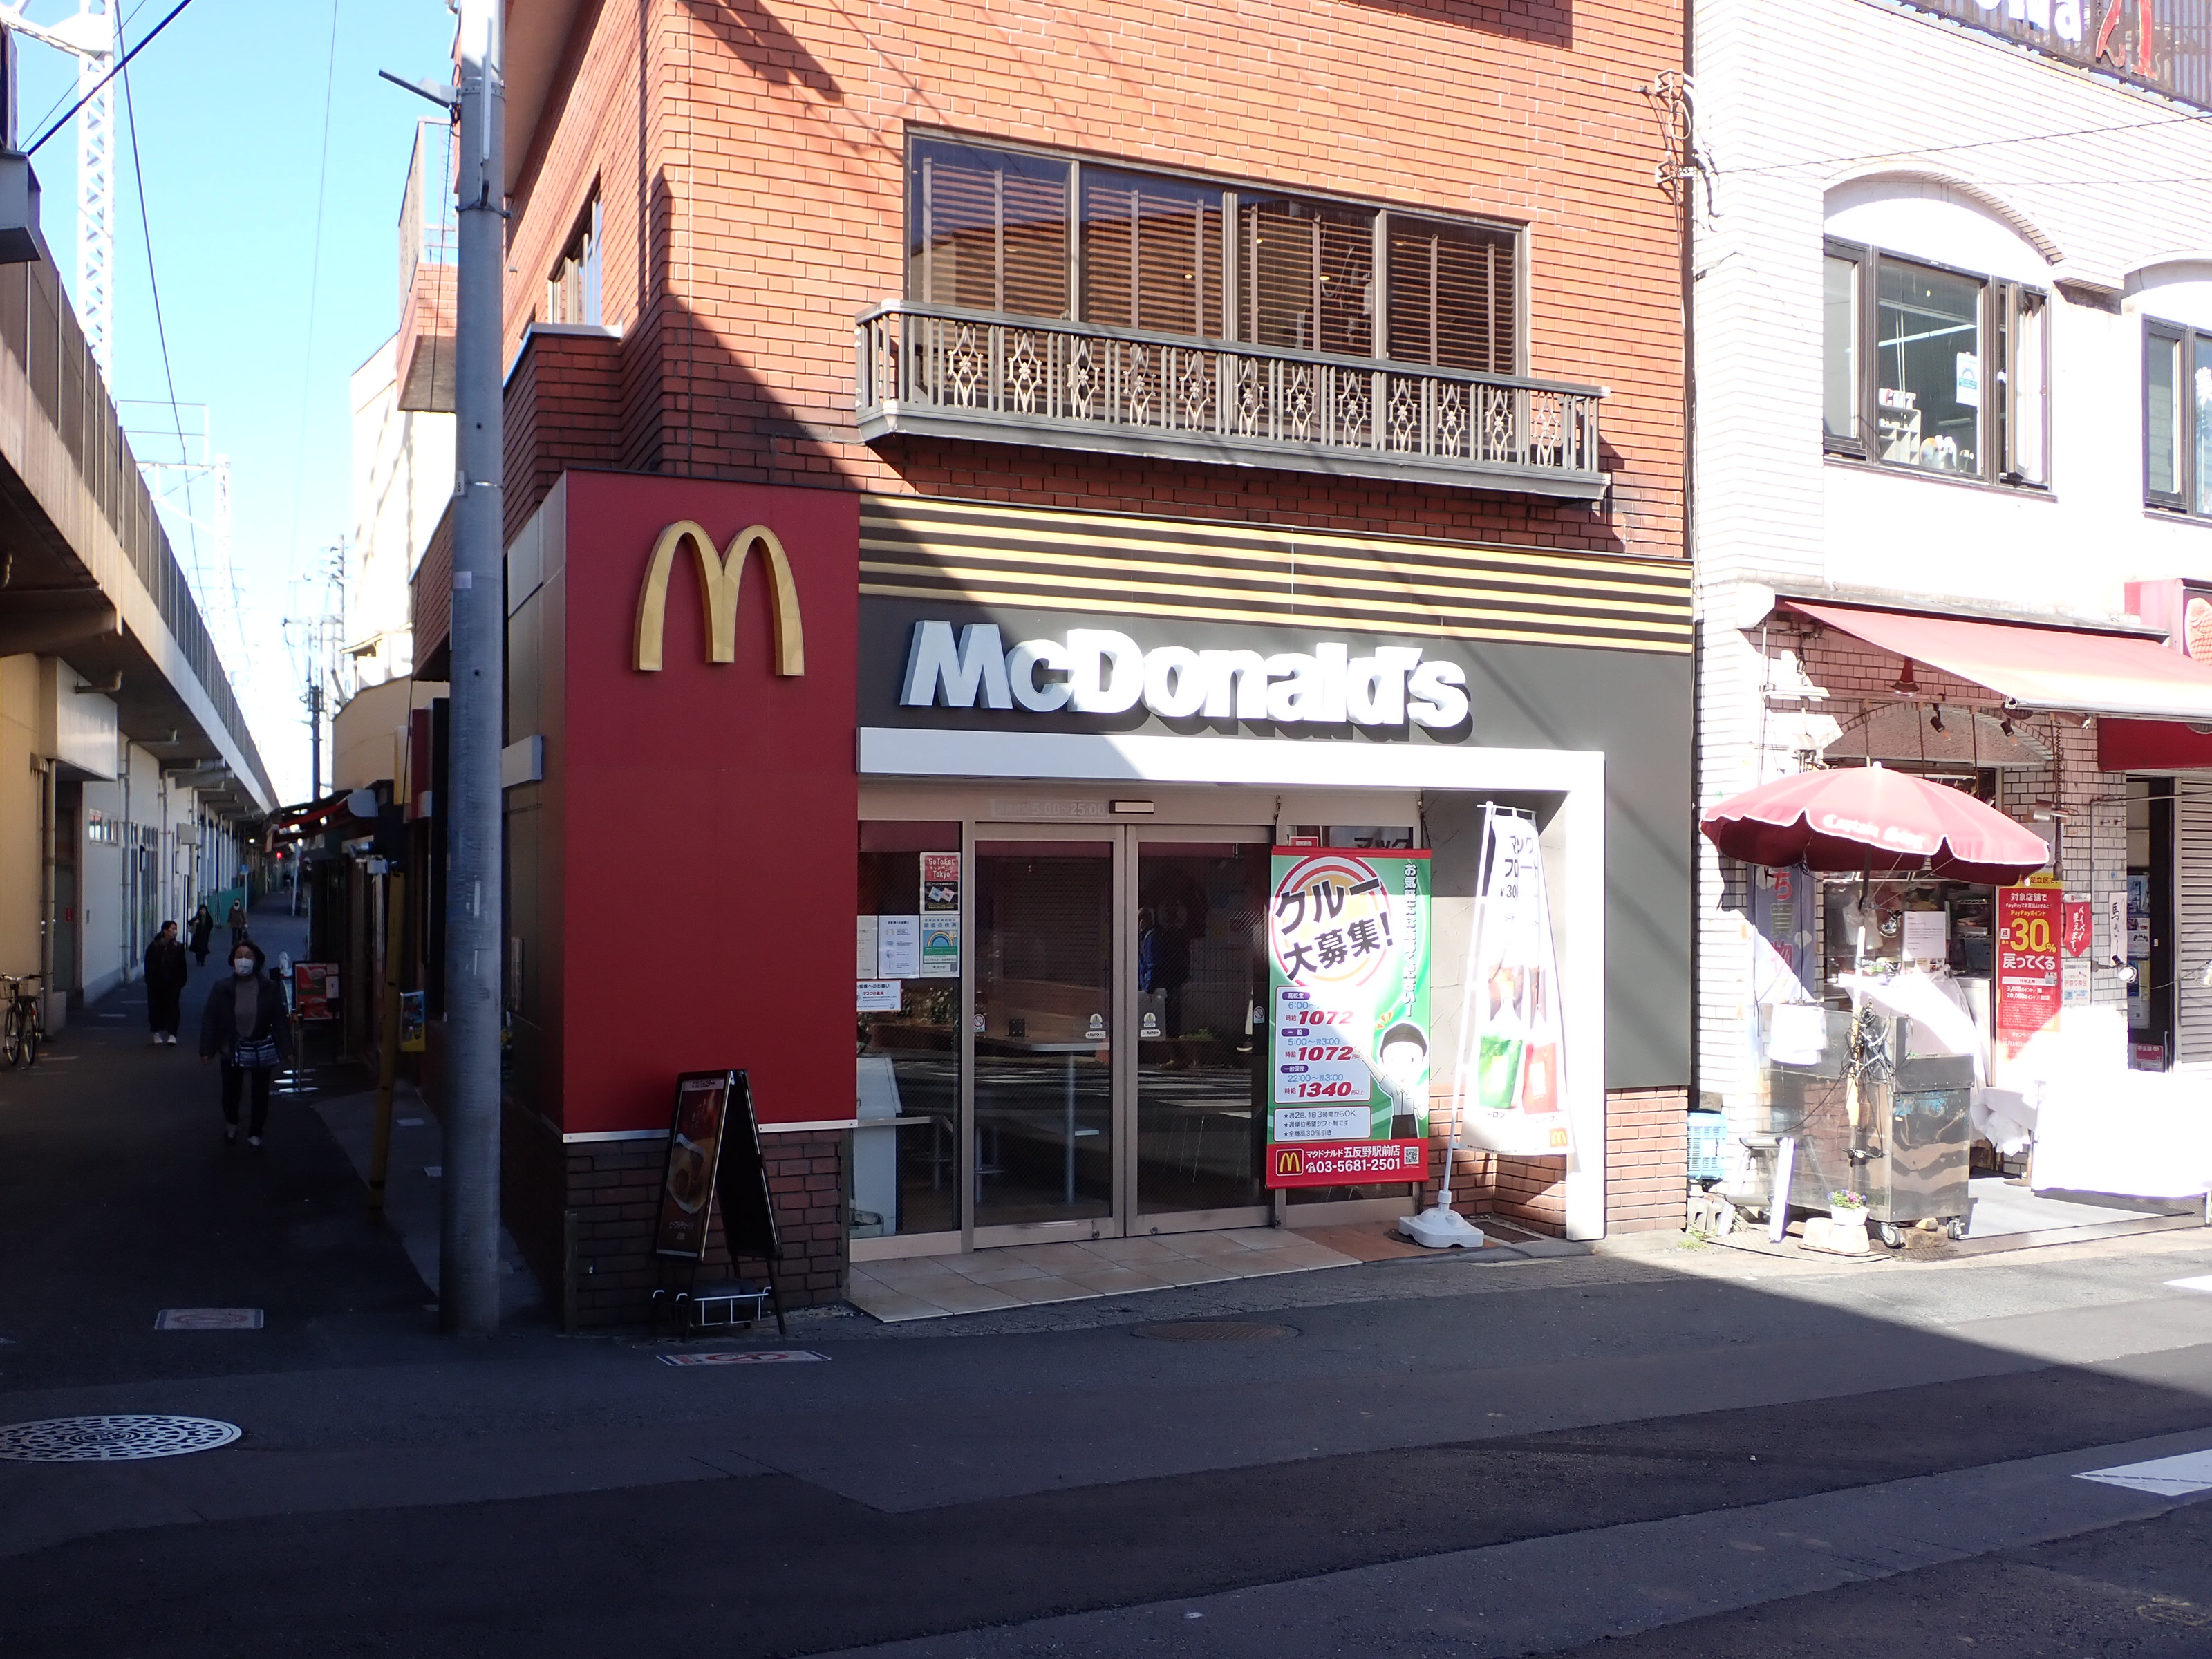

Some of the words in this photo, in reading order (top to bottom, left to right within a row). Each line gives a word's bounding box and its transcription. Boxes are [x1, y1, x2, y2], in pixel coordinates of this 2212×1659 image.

[899, 619, 1471, 729] McDonald's
[933, 870, 950, 879] Tokyo
[1275, 877, 1380, 935] クルー
[2077, 906, 2086, 941] ペイペイ
[2003, 953, 2056, 971] 戻ってくる
[1316, 1157, 1401, 1174] 03-5681-2501
